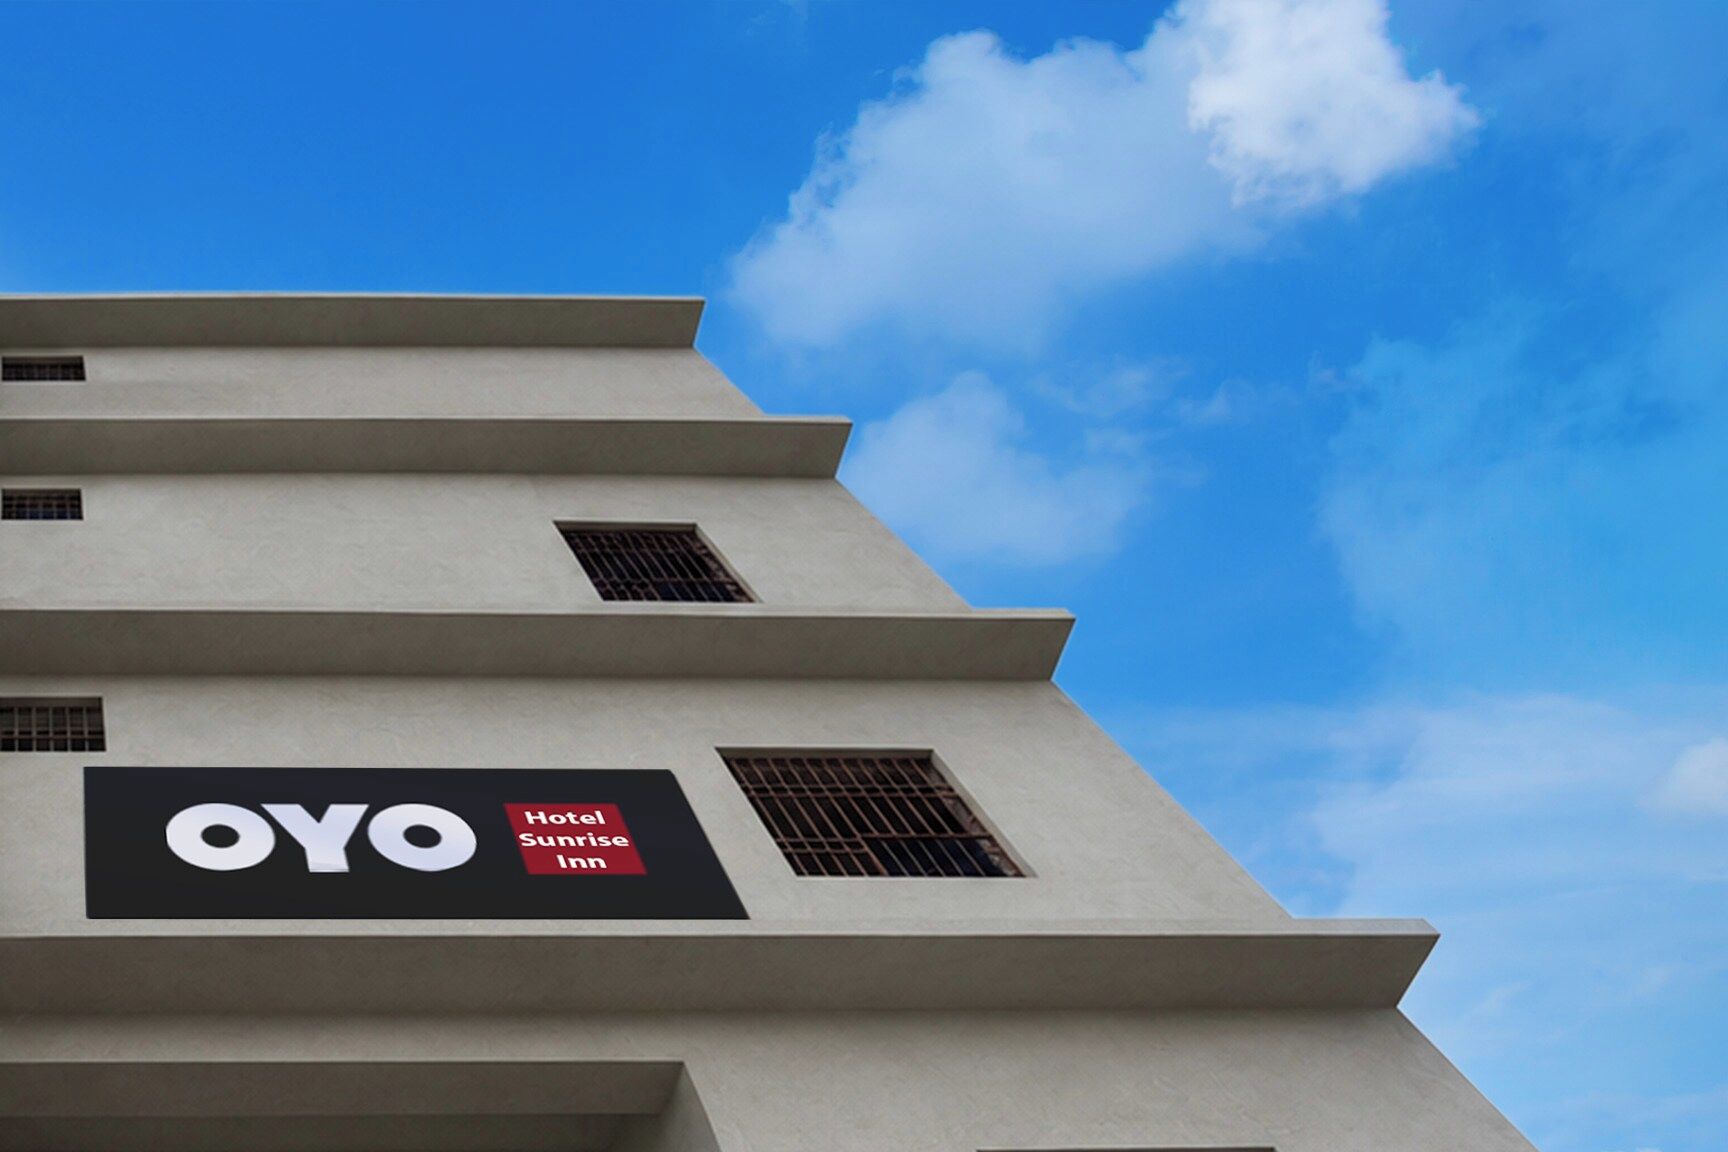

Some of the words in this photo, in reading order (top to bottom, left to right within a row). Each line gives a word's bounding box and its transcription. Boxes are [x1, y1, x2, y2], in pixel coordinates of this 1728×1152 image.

[524, 810, 606, 825] Hotel
[165, 802, 477, 873] OYO
[518, 832, 630, 847] Sunrise
[556, 854, 607, 869] Inn
